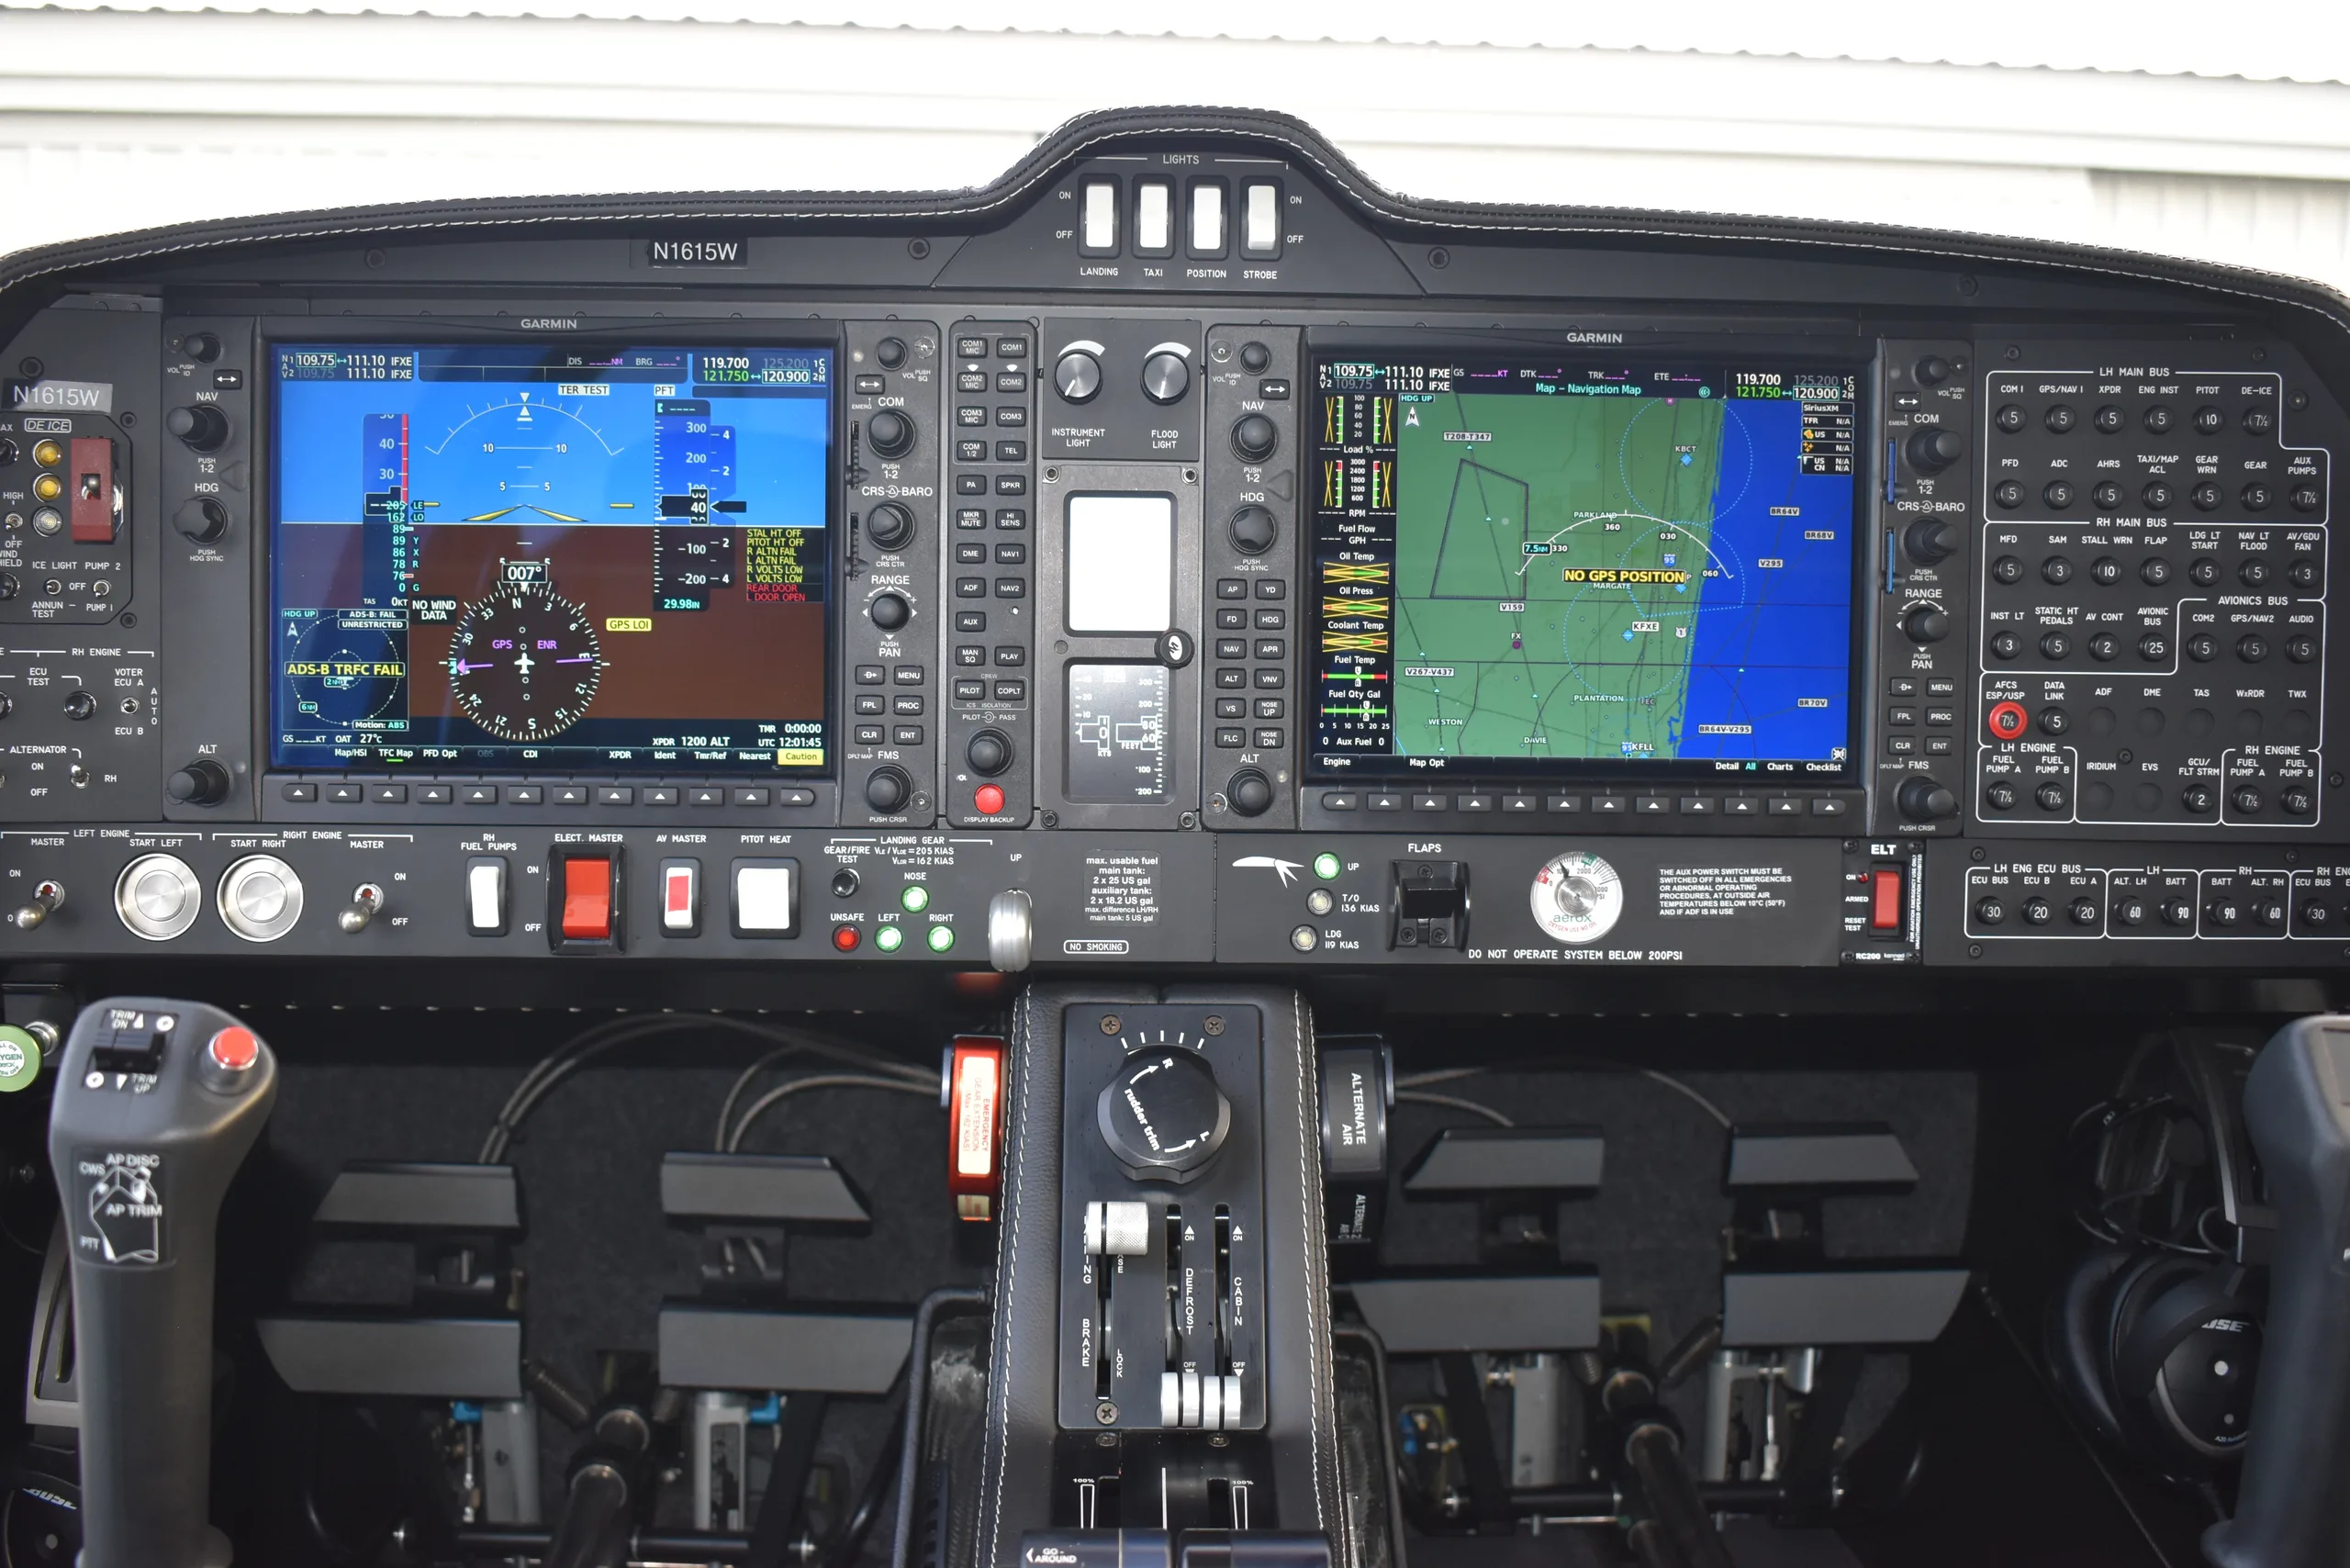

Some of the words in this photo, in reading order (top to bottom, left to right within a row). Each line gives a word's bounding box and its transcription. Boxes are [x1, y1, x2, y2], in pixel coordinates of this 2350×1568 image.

[1163, 155, 1199, 164] LIGHTS
[1057, 230, 1072, 239] OFF
[653, 241, 739, 261] N1615W
[1144, 268, 1162, 276] TAXI
[1187, 269, 1226, 277] POSITION
[1244, 271, 1277, 279] STROBE
[521, 319, 576, 329] GARMIN
[1567, 333, 1622, 342] GARMIN
[348, 355, 385, 365] 111.10
[391, 357, 412, 366] IFXE
[704, 357, 749, 368] 119.700
[2100, 367, 2112, 375] LH
[2150, 368, 2169, 376] BUS
[704, 371, 748, 381] 121.750
[764, 372, 808, 382] 120.900
[1737, 374, 1781, 385] 119.700
[560, 386, 578, 395] TER
[584, 386, 608, 395] TEST
[655, 386, 674, 395] PFT
[1537, 383, 1555, 394] Map
[1568, 384, 1618, 395] Navigation
[1622, 385, 1640, 396] Map
[13, 386, 100, 407] N1615W
[196, 392, 218, 400] NAV
[878, 398, 903, 406] COM
[27, 421, 46, 431] DE
[48, 421, 69, 431] ICE
[687, 422, 706, 432] 300
[196, 483, 218, 492] HDG
[862, 487, 884, 496] CRS
[902, 487, 933, 496] BARO
[1339, 524, 1355, 532] Fuel
[747, 529, 767, 538] STAL
[771, 530, 783, 538] HT
[786, 529, 801, 538] OFF
[872, 576, 910, 584] RANGE
[1564, 571, 1584, 581] NO
[1588, 571, 1617, 581] GPS
[1620, 571, 1684, 582] POSITION
[747, 584, 770, 592] REAR
[773, 584, 797, 592] DOOR
[413, 600, 428, 610] NO
[431, 600, 456, 610] WIND
[2219, 596, 2261, 605] AVIONICS
[2268, 597, 2288, 605] BUS
[32, 610, 54, 618] TEST
[421, 610, 447, 620] DATA
[2231, 614, 2274, 622] GPS/NAV2
[610, 621, 630, 629] GPS
[1363, 622, 1383, 631] Temp
[879, 648, 901, 656] PAN
[2150, 643, 2163, 653] 25
[287, 665, 329, 676] ADS-B
[334, 665, 369, 676] TRFC
[374, 665, 402, 676] FAIL
[779, 738, 821, 747] 12:01:45
[10, 745, 66, 754] ALTERNATOR
[335, 749, 366, 757] Map/HSI
[397, 749, 413, 758] Map
[1324, 757, 1350, 767] Engine
[1908, 761, 1929, 769] FMS
[2087, 762, 2116, 770] IRIDIUM
[1807, 763, 1841, 771] Checklist
[554, 834, 584, 843] ELECT.
[1408, 844, 1441, 853] FLAPS
[1871, 845, 1897, 855] ELT
[1469, 949, 1482, 958] DO
[1488, 949, 1507, 958] NOT
[1514, 950, 1558, 958] OPERATE
[1564, 950, 1603, 959] SYSTEM
[1609, 950, 1642, 959] BELOW
[1649, 951, 1682, 960] 200PSI
[1350, 1072, 1367, 1146] ALTERNATE
[1125, 1088, 1149, 1126] rudder
[1144, 1124, 1161, 1151] trim
[1342, 1124, 1353, 1146] AIR
[106, 1154, 125, 1167] AP
[106, 1204, 125, 1216] AP
[129, 1204, 162, 1216] TRIM
[1035, 1554, 1077, 1563] AROUND
